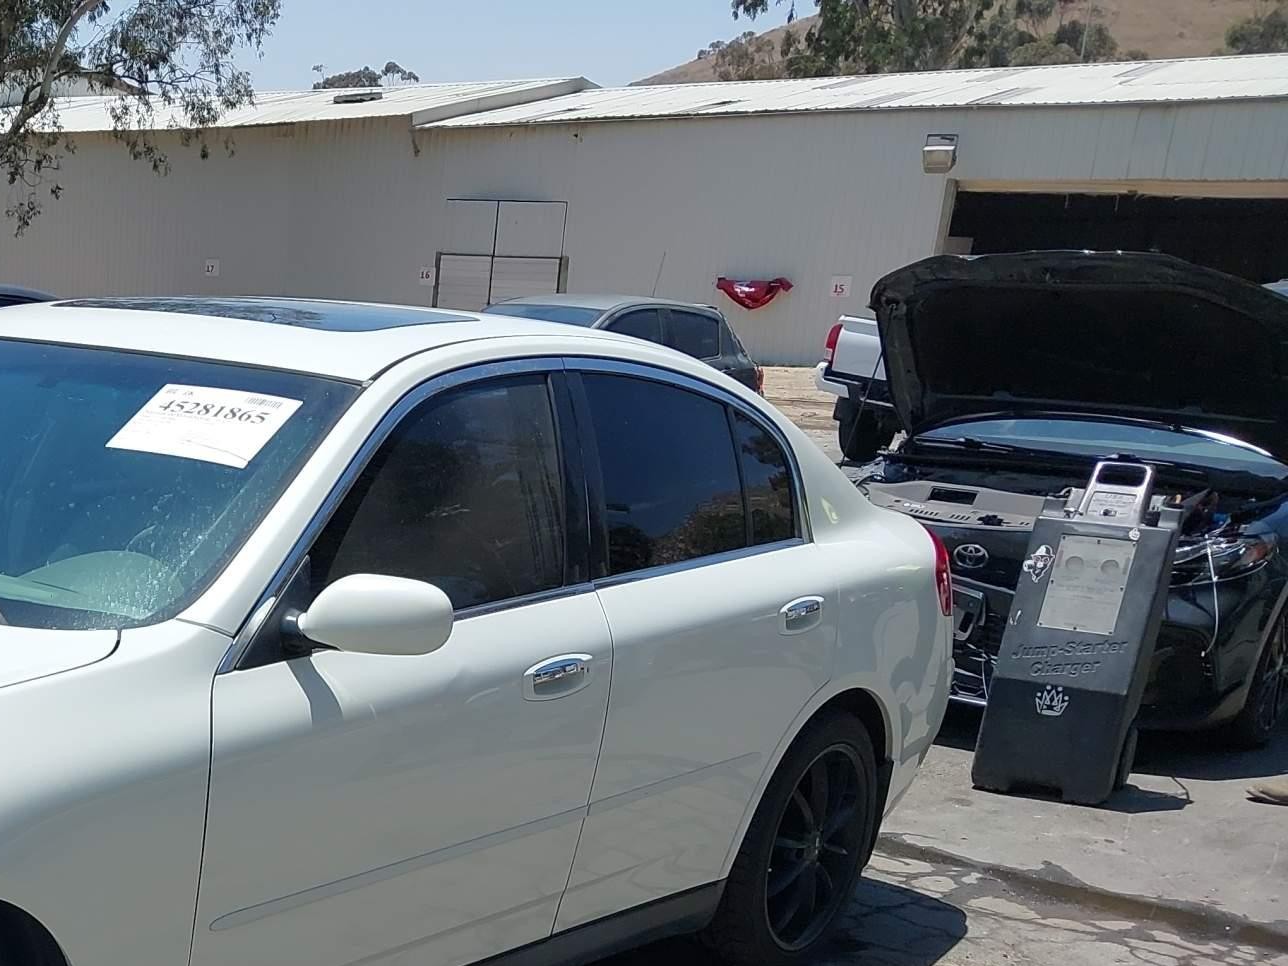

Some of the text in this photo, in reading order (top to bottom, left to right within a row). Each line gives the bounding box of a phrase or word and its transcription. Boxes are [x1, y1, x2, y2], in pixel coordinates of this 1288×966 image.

[206, 264, 215, 273] 17
[832, 283, 846, 294] 15
[159, 399, 271, 425] 45281865
[1011, 639, 1129, 660] Jump-Starter
[1030, 660, 1102, 677] Charger
